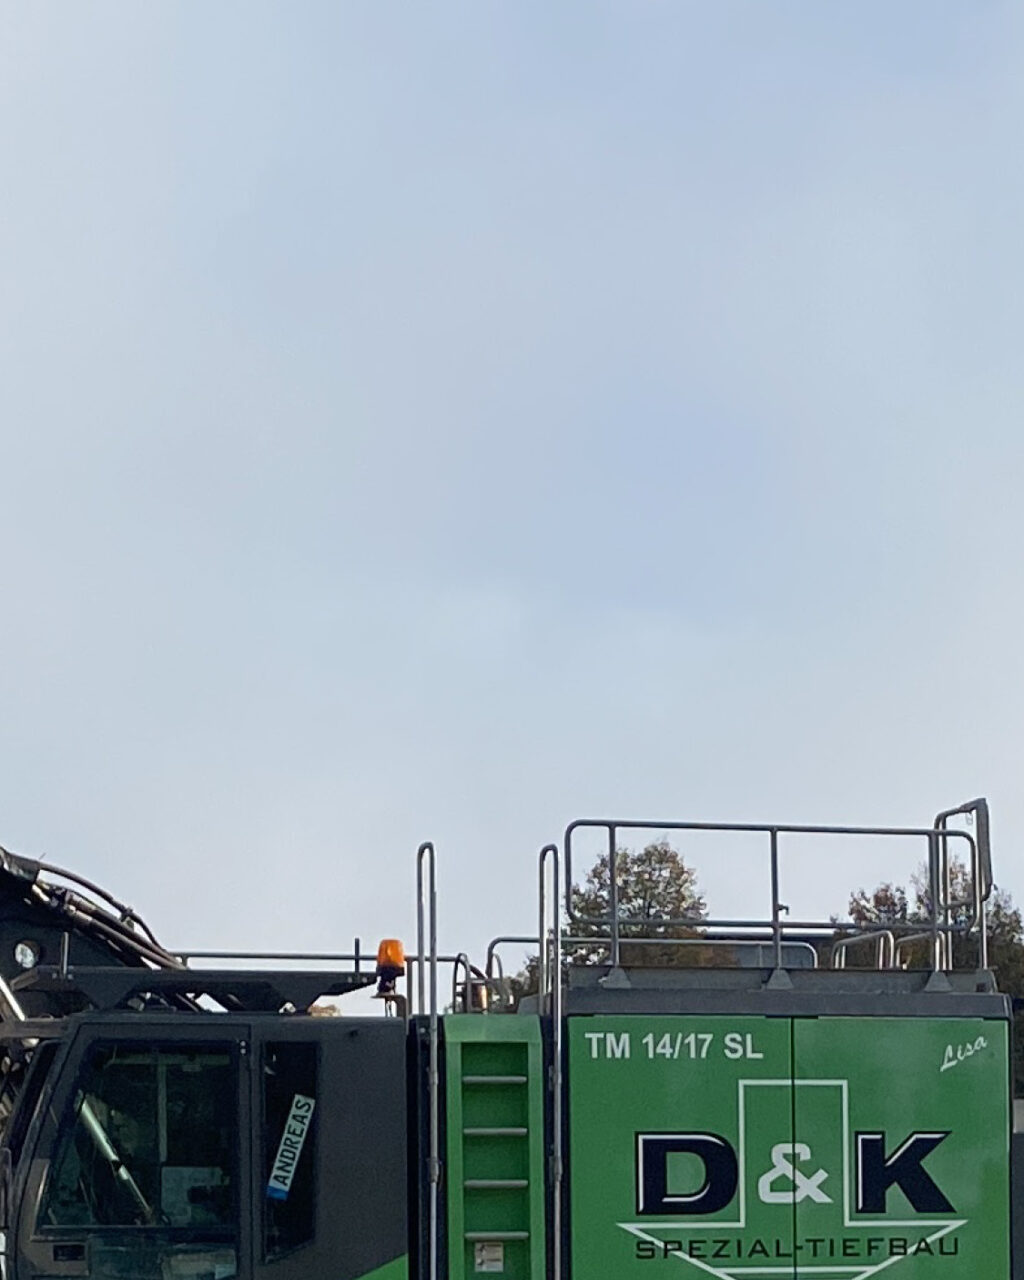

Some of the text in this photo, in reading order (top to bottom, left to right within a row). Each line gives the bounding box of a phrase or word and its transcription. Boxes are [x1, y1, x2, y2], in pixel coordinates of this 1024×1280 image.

[584, 1032, 765, 1060] TM 14/17 SL
[939, 1033, 989, 1073] Lisa
[272, 1097, 313, 1187] ANDREAS
[634, 1237, 960, 1261] SPEZIAL-TIEFBAU
